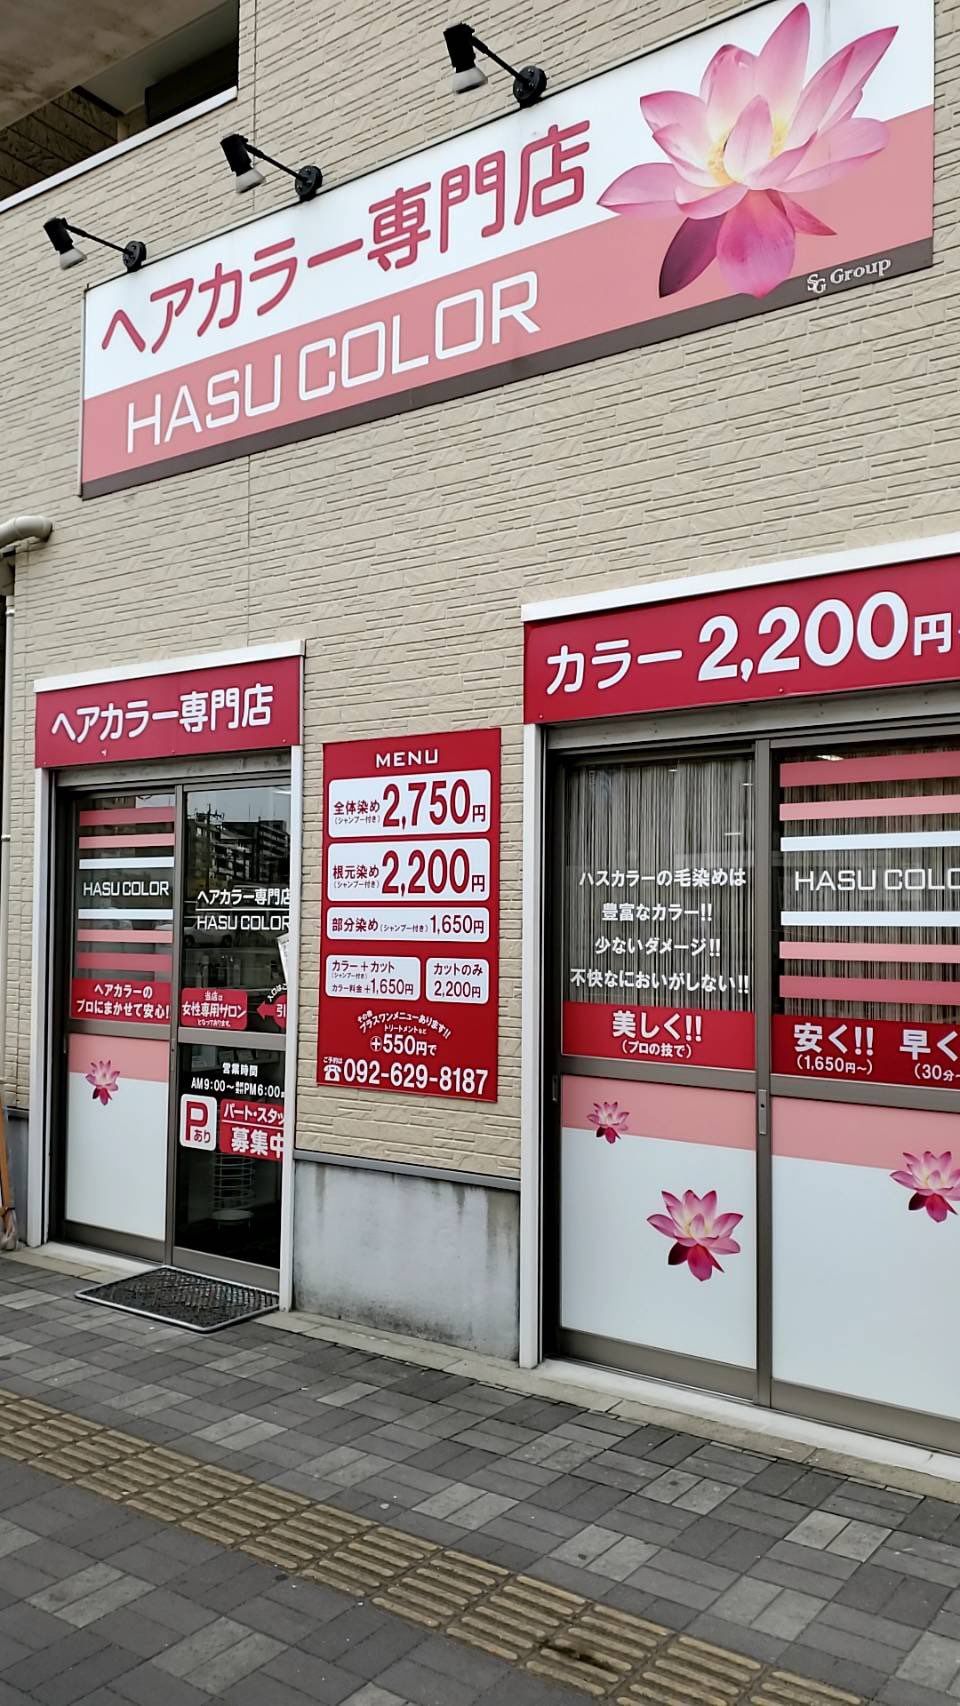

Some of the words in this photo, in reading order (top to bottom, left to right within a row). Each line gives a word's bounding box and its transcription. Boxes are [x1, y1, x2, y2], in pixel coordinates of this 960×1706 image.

[102, 120, 591, 354] ヘアカラー専門店
[830, 258, 892, 285] Group
[127, 354, 282, 454] HASU
[299, 271, 541, 402] COLOR
[546, 638, 684, 695] カラー
[698, 590, 960, 683] 2,200円
[51, 682, 274, 743] ヘアカラー専門店
[375, 748, 439, 769] MENU
[333, 800, 381, 815] 全体染め
[382, 778, 487, 830] 2,750円
[332, 864, 380, 880] 根元染め
[381, 848, 485, 897] 2,200円
[579, 867, 747, 888] ハスカラーの毛染めは
[795, 868, 877, 892] HASU
[83, 881, 120, 896] HASU
[122, 881, 170, 896] COLOR
[197, 887, 290, 906] ヘアカラー専門店
[601, 902, 713, 922] 豊富なカラー!!
[197, 915, 238, 931] HASU
[331, 917, 379, 932] 部分染め
[430, 914, 485, 935] 1,650円
[594, 936, 721, 957] 少ないダメージ!!
[433, 962, 484, 977] カットのみ
[94, 983, 153, 999] ヘアカラーの
[434, 980, 482, 999] 2,200円
[570, 968, 750, 994] 不快なにおいがしない!!
[204, 990, 224, 1002] 当店は
[76, 999, 170, 1019] プロにまかせて安心!
[182, 1001, 247, 1019] 女性専用サロン
[612, 1010, 703, 1042] 美しく!!
[622, 1040, 692, 1059] (プロの技で)
[794, 1022, 875, 1057] 安く!!
[222, 1062, 259, 1078] 営業時間
[343, 1058, 489, 1096] 092-629-8187
[185, 1100, 209, 1141] P
[193, 1129, 211, 1144] あり
[231, 1126, 285, 1159] 募集中
